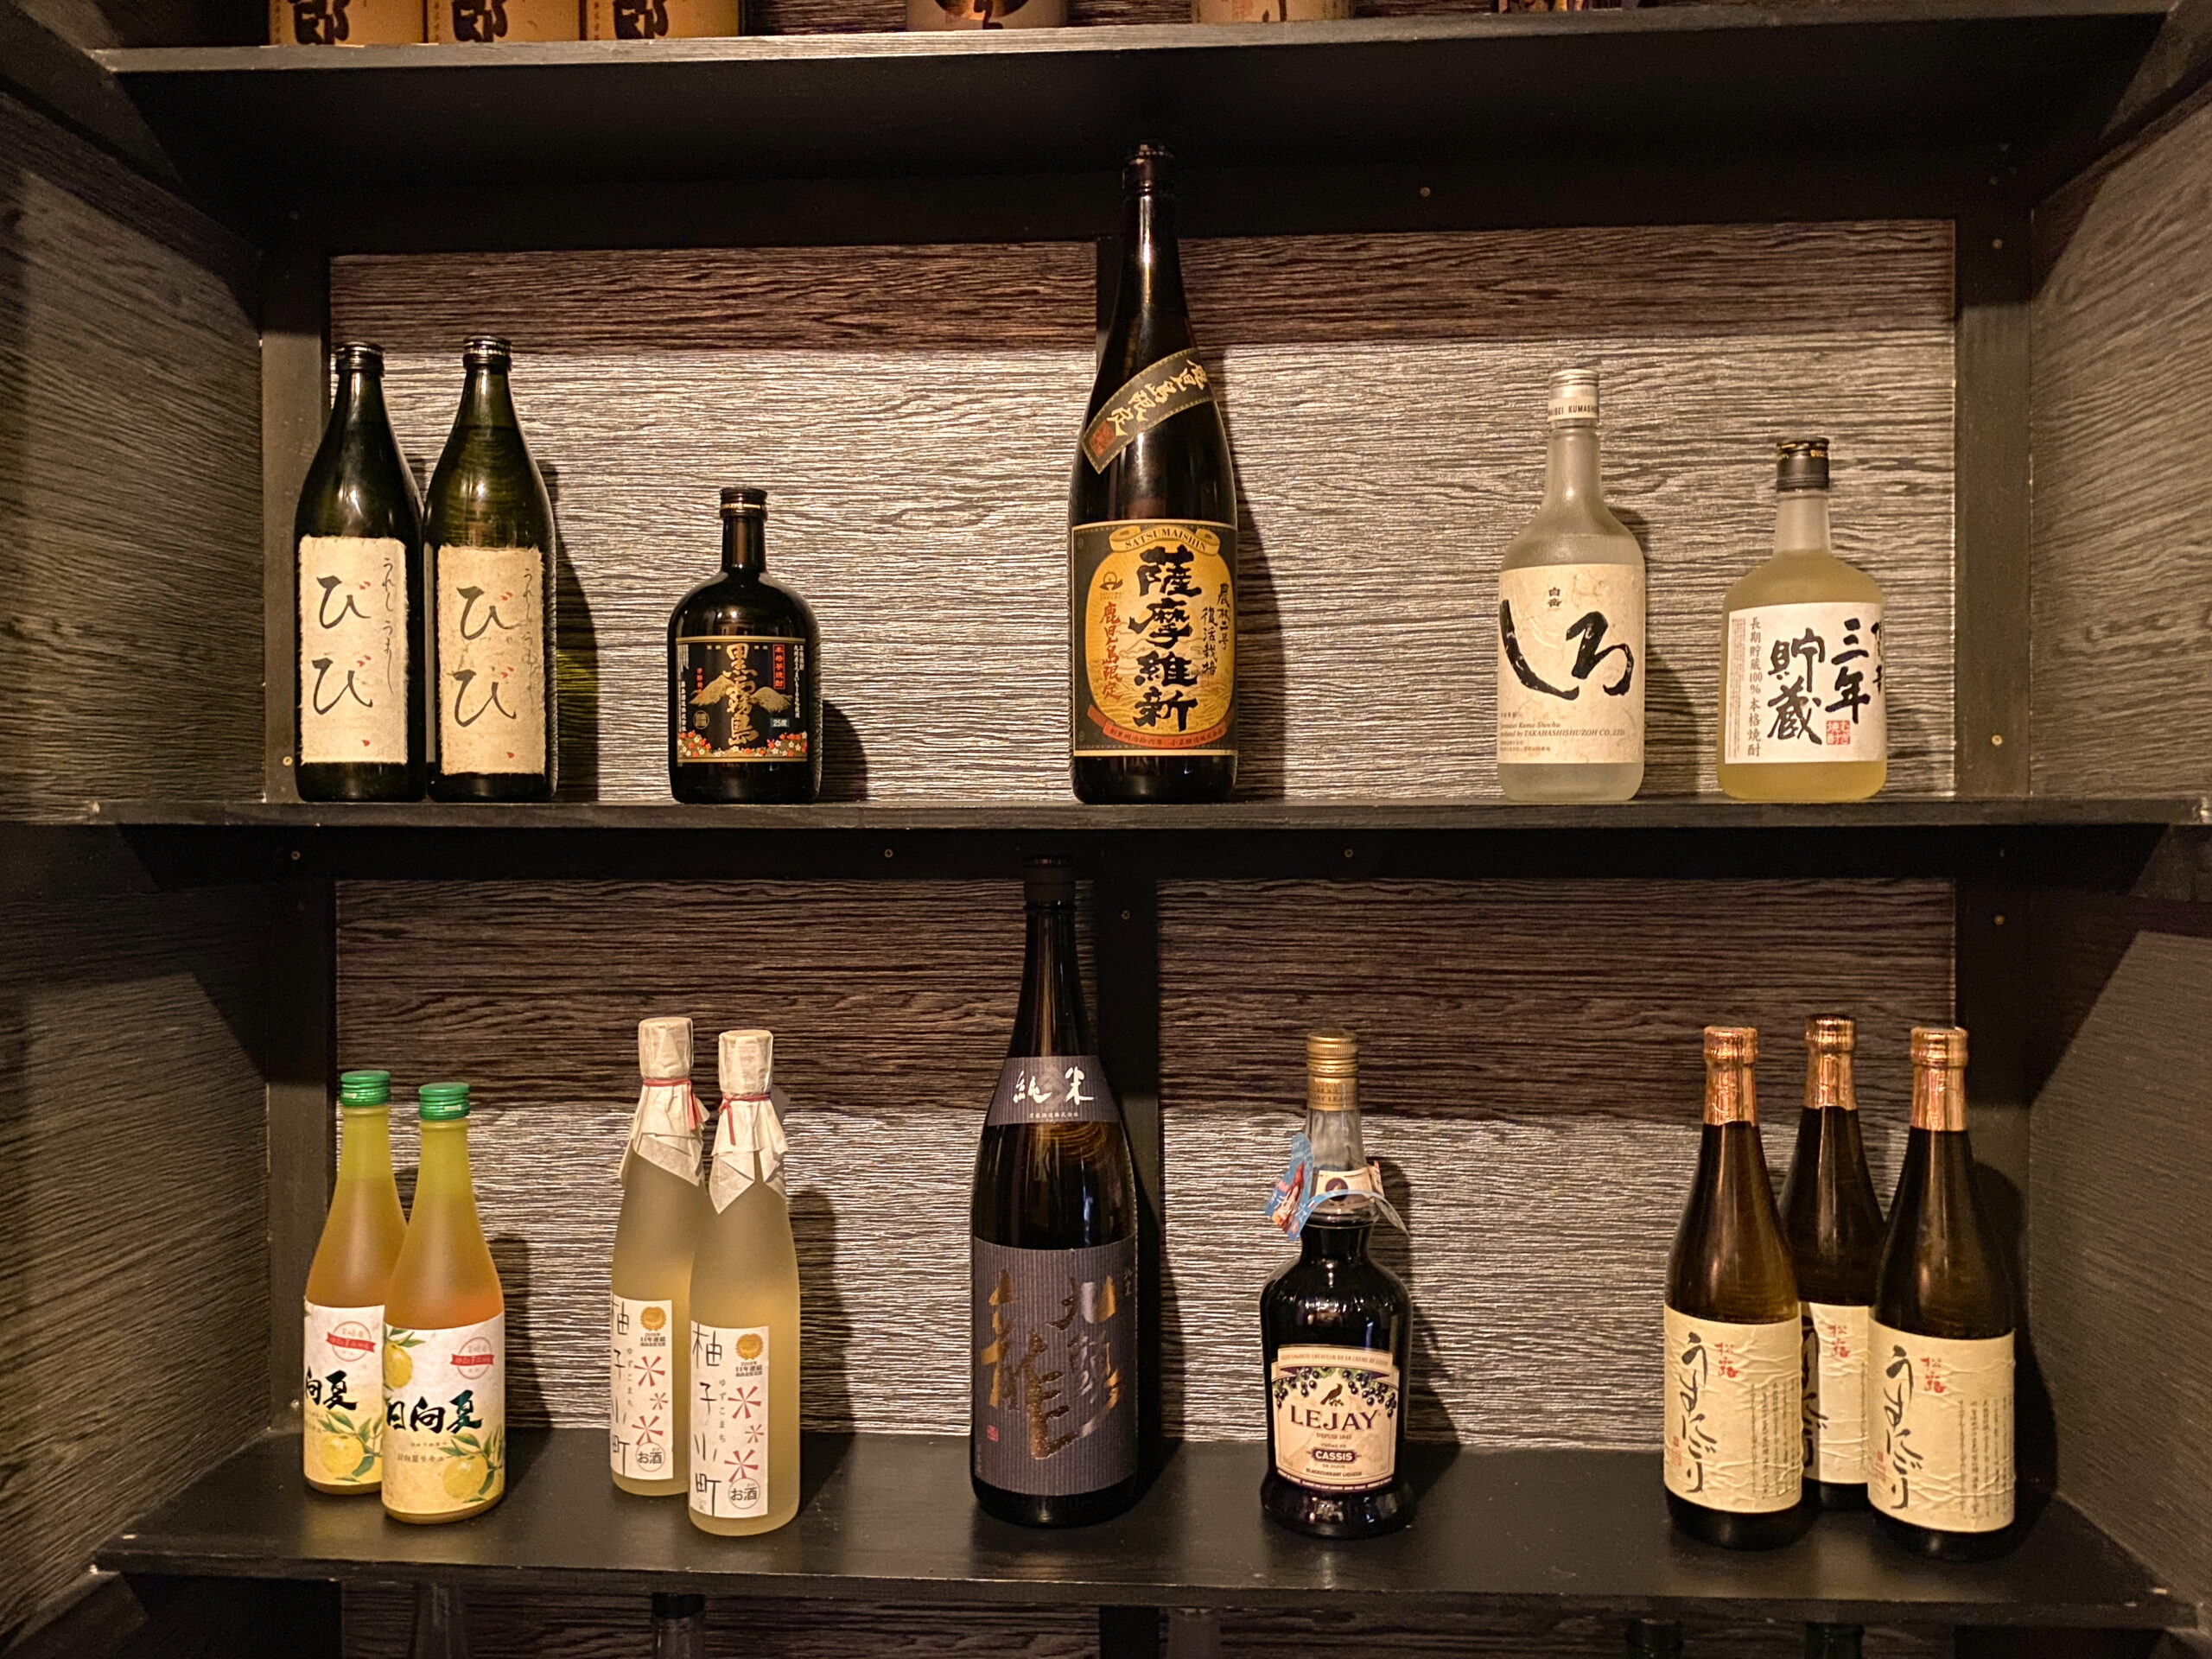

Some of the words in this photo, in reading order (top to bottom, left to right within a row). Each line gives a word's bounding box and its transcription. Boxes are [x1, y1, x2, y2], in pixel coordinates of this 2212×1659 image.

[1125, 528, 1207, 551] SATSUMAISHIN
[1099, 601, 1123, 701] 鹿児島限定
[1128, 545, 1202, 733] 薩摩維新
[1500, 599, 1635, 701] しろ
[1825, 618, 1871, 724] 三年
[1767, 627, 1826, 745] 貯蔵
[1290, 1404, 1378, 1432] LEJAY
[637, 1451, 663, 1465] お酒
[1315, 1450, 1353, 1461] CASSIS
[730, 1487, 758, 1502] お酒
